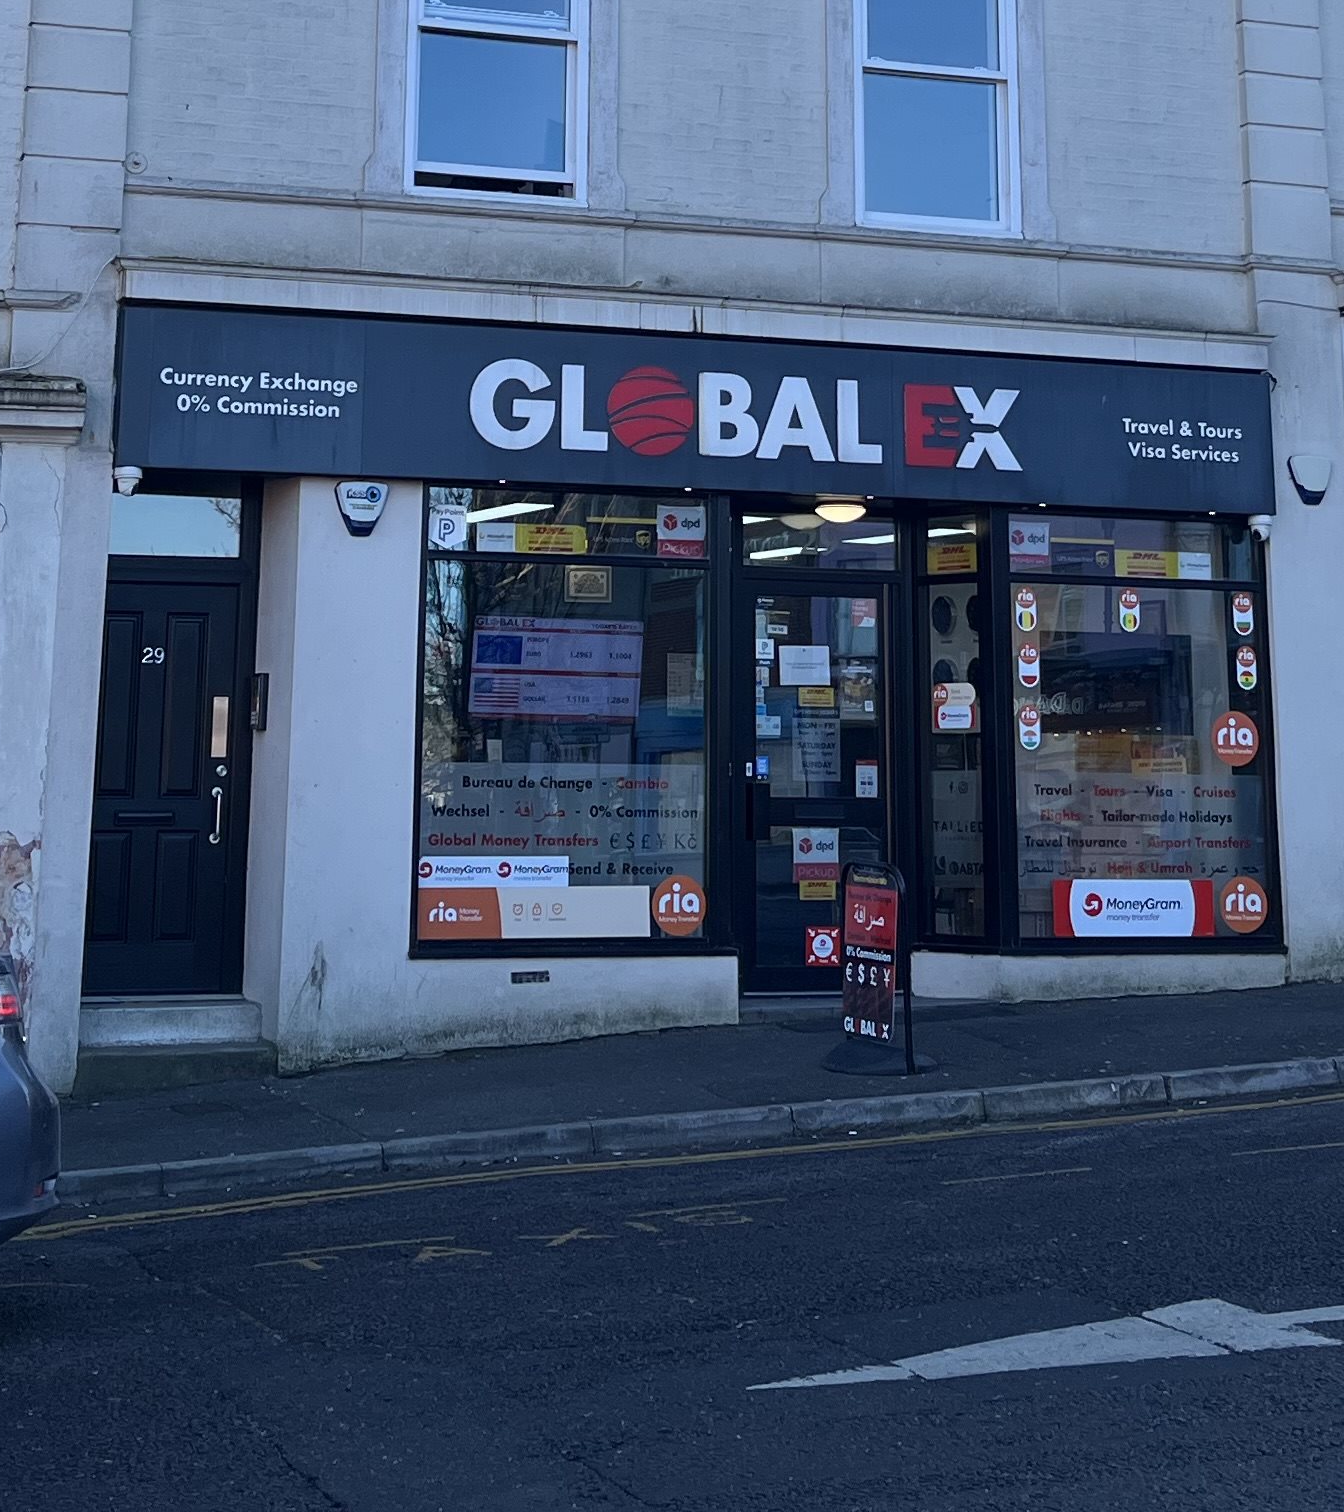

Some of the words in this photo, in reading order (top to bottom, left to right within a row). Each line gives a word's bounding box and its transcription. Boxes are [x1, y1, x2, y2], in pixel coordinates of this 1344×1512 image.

[159, 367, 253, 393] Currency
[259, 372, 358, 397] Exchange
[176, 394, 211, 413] 0%
[217, 396, 340, 418] Commission
[469, 357, 883, 466] GLOBAL
[903, 383, 1024, 473] EX
[1122, 417, 1175, 437] Travel
[1179, 421, 1194, 437] &
[1198, 422, 1243, 440] Tours
[1128, 442, 1166, 460] Visa
[1171, 444, 1240, 463] Services
[681, 518, 700, 530] dpd
[1027, 533, 1046, 544] dpd
[1018, 589, 1034, 602] ria
[1121, 590, 1137, 603] ria
[1234, 594, 1250, 606] ria
[141, 647, 164, 664] 29
[1021, 645, 1037, 658] ria
[1238, 648, 1254, 661] ria
[1021, 707, 1038, 720] ria
[1217, 718, 1254, 746] ria
[462, 776, 513, 788] Bureau
[518, 776, 535, 788] de
[540, 777, 592, 792] Change
[616, 777, 669, 789] Cambio
[1034, 784, 1072, 795] Travel
[1093, 785, 1126, 796] Tours
[1146, 785, 1173, 797] Visa
[1193, 786, 1236, 798] Cruises
[432, 804, 490, 817] Wechsel
[590, 805, 611, 817] 0%
[616, 805, 698, 818] Commission
[1040, 809, 1082, 824] Flights
[1101, 810, 1174, 822] Tailor-made
[1179, 810, 1233, 826] Holidays
[428, 833, 476, 846] Global
[481, 834, 529, 849] Money
[534, 833, 599, 847] Transfers
[609, 833, 621, 849] €
[626, 832, 635, 851] $
[641, 833, 651, 849] £
[816, 841, 834, 853] dpd
[1025, 835, 1063, 847] Travel
[1067, 836, 1128, 848] Insurance
[1147, 836, 1191, 851] Airport
[1195, 836, 1252, 848] Transfers
[435, 864, 490, 876] MoneyGram
[514, 864, 568, 876] MoneyGram
[569, 862, 601, 875] Send
[607, 862, 616, 875] &
[622, 862, 674, 875] Receive
[1107, 861, 1133, 876] Hajj
[1137, 862, 1146, 873] &
[1151, 861, 1192, 874] Umrah
[659, 882, 700, 913] ria
[1225, 884, 1262, 912] ria
[429, 901, 457, 922] ria
[1106, 898, 1181, 913] MoneyGram
[854, 903, 885, 931] صرافة
[1131, 913, 1160, 922] transfer
[856, 947, 892, 962] Commission
[846, 962, 853, 982] €
[858, 962, 865, 985] $
[870, 966, 877, 986] £
[883, 968, 891, 988] ¥
